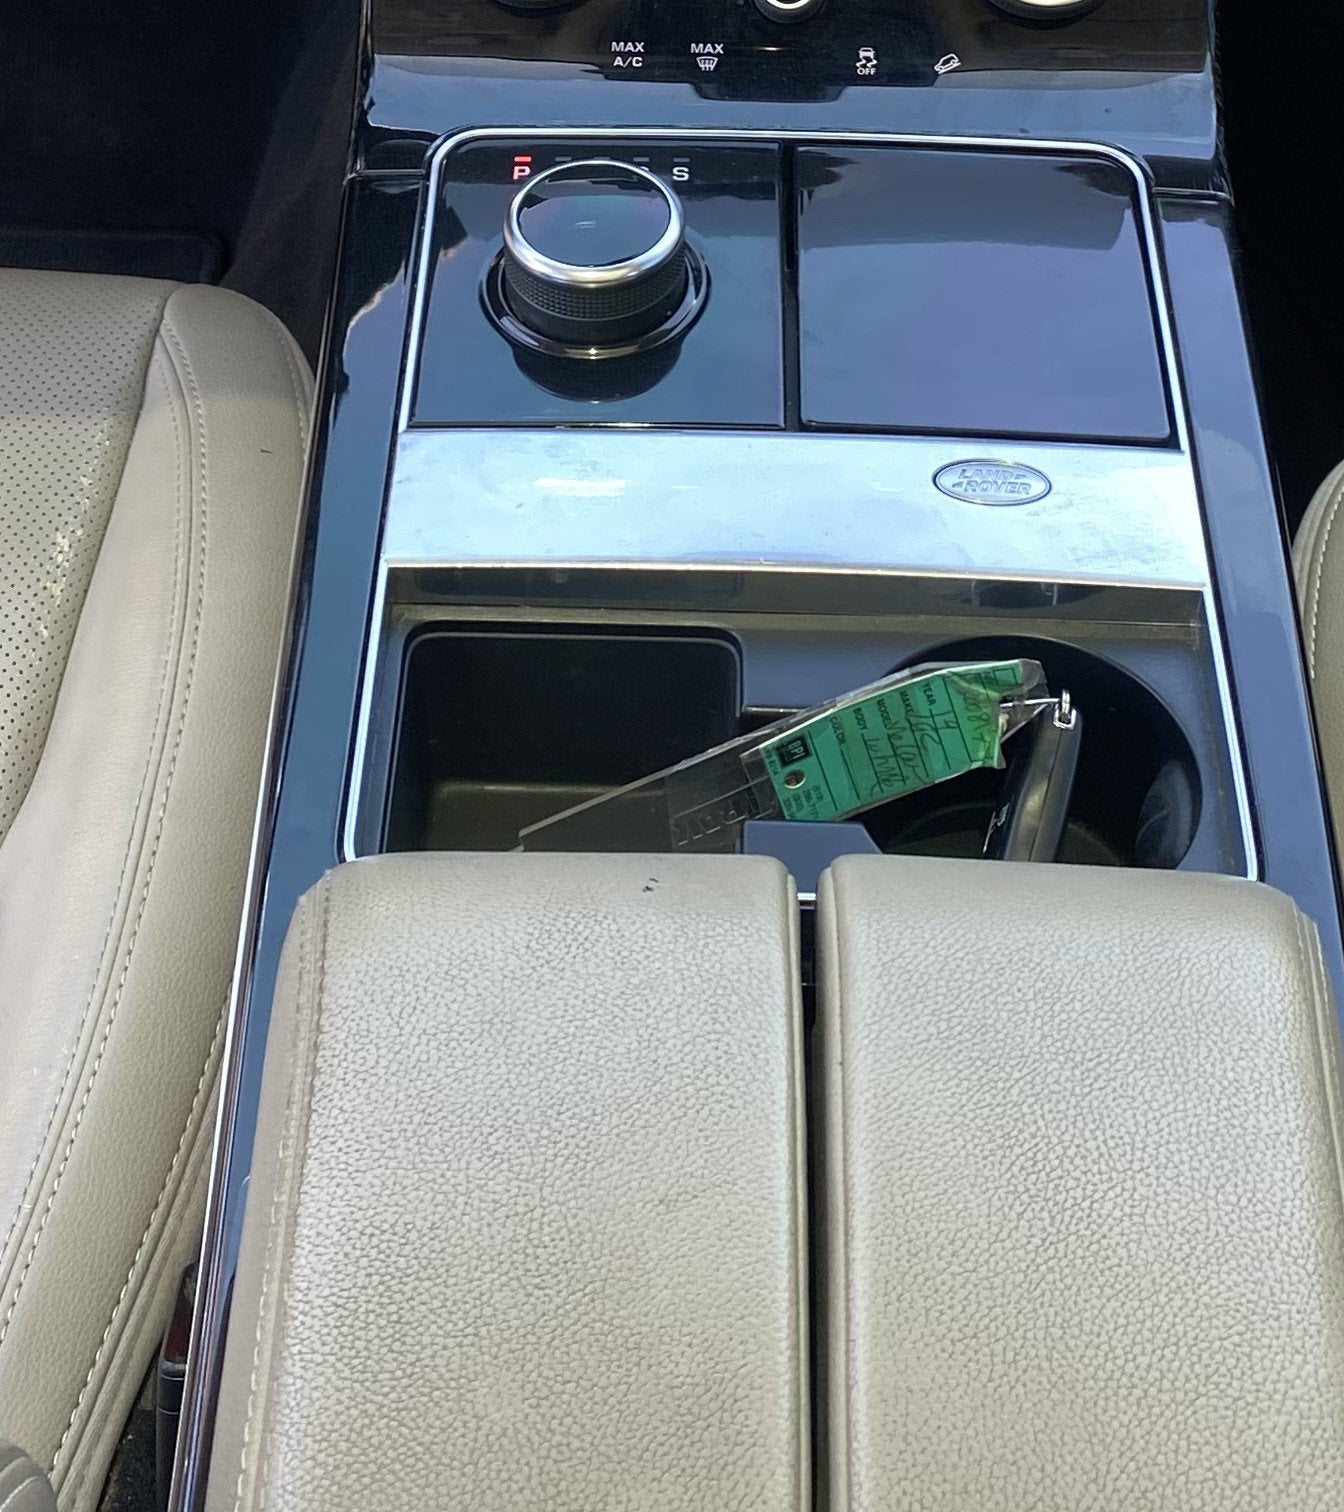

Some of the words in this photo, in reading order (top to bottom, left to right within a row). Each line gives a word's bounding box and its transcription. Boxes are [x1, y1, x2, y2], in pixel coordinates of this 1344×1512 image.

[610, 41, 645, 53] MAX
[690, 42, 724, 54] MAX
[612, 55, 643, 68] A/C
[856, 67, 877, 76] OFF
[512, 165, 531, 180] P
[671, 166, 690, 181] S
[958, 468, 1015, 481] LAND
[962, 480, 1033, 495] ROVER
[923, 682, 937, 707] YEAR
[899, 690, 915, 714] MAKE
